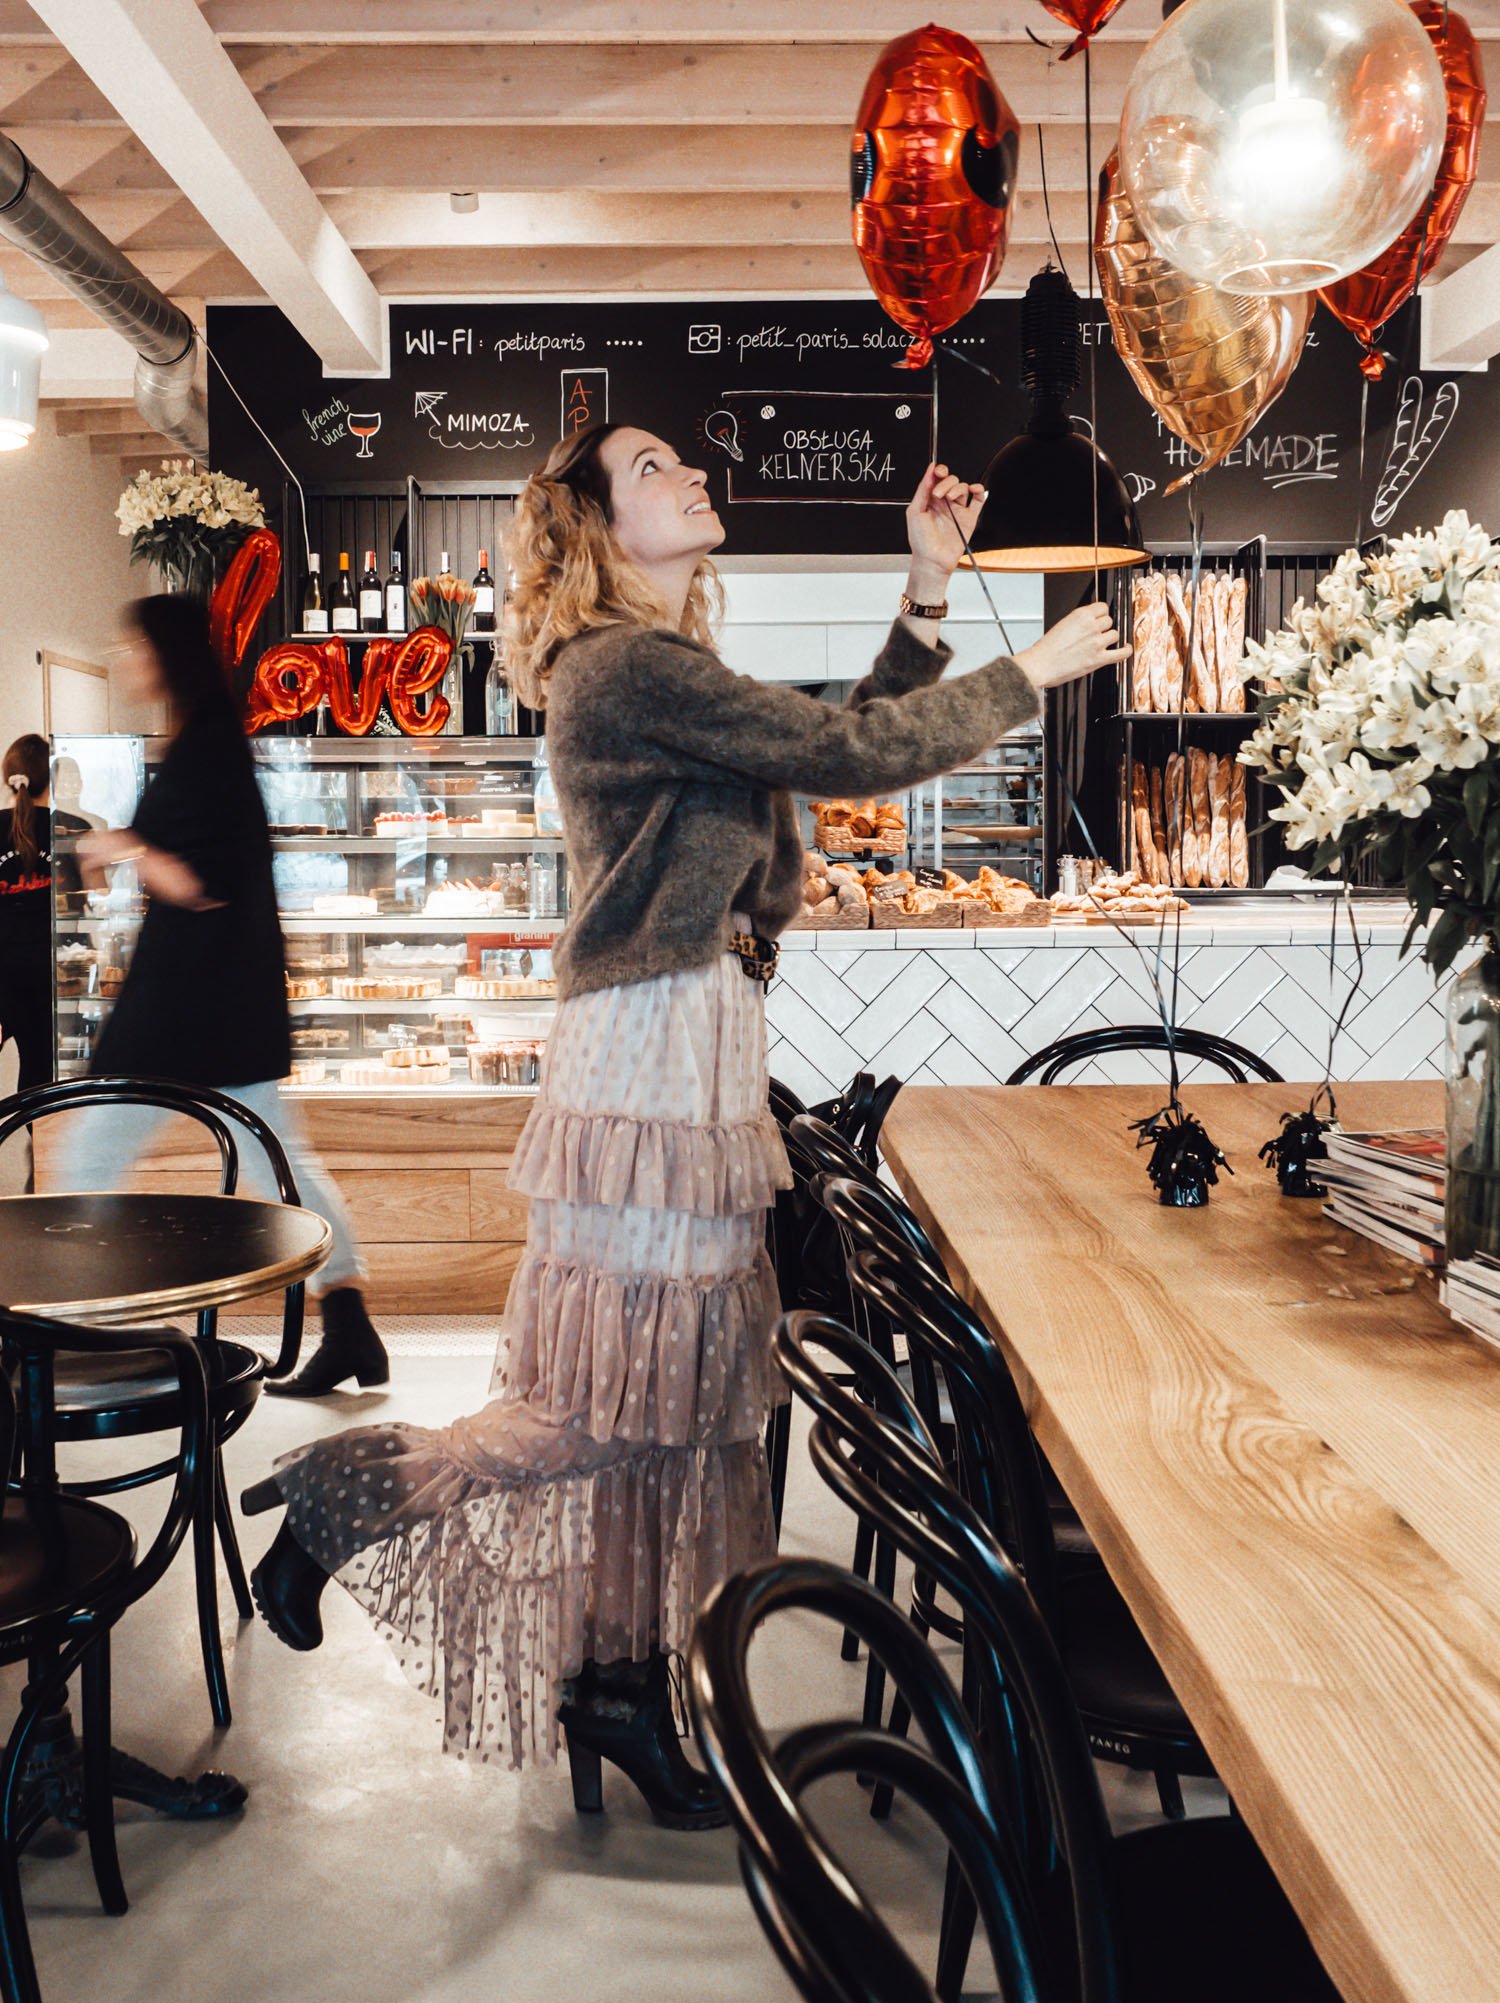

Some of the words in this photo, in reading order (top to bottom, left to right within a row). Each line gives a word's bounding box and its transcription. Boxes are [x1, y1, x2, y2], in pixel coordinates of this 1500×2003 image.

[447, 413, 530, 433] MIMOZA
[783, 429, 874, 452] OBSŁUGA
[1163, 433, 1339, 473] HOEMADE
[758, 452, 896, 482] KELNERSKA
